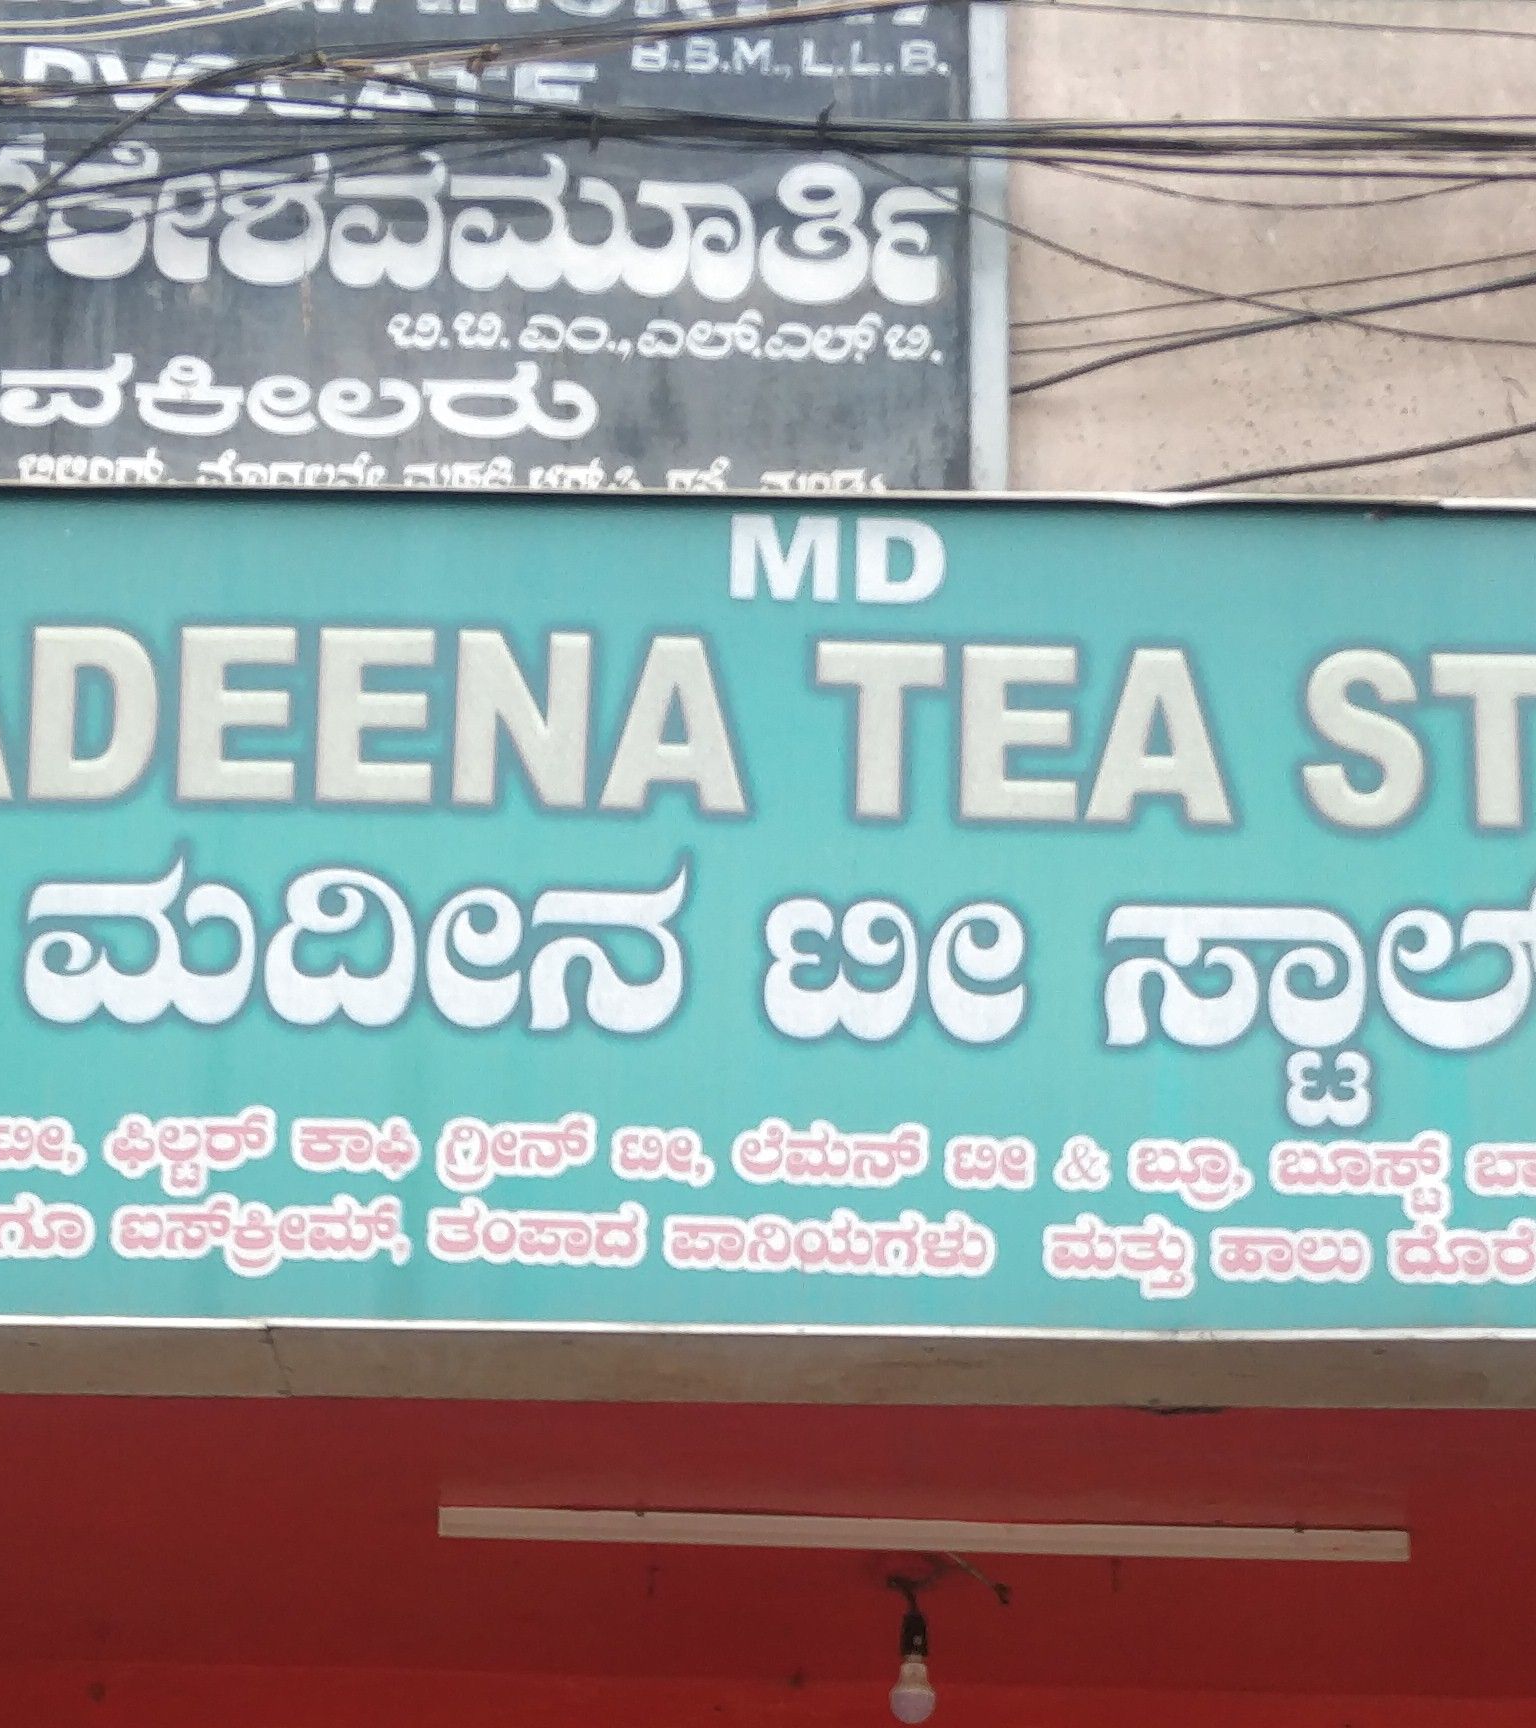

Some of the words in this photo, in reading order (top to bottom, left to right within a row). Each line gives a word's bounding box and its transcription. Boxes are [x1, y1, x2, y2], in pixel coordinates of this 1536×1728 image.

[727, 511, 950, 605] MD
[813, 638, 1234, 835] TEA
[20, 855, 694, 1037] ಮದೀನ
[763, 896, 1027, 1038] ಟೀ
[436, 1112, 598, 1192] ಗ್ರೀನ್
[731, 1115, 930, 1188] ಲೆಮನ್
[943, 1132, 1036, 1191] ಟೀ
[1054, 1134, 1111, 1191] &
[1044, 1211, 1196, 1300] ಮತ್ತು
[1209, 1226, 1373, 1283] ಹಾಲು
